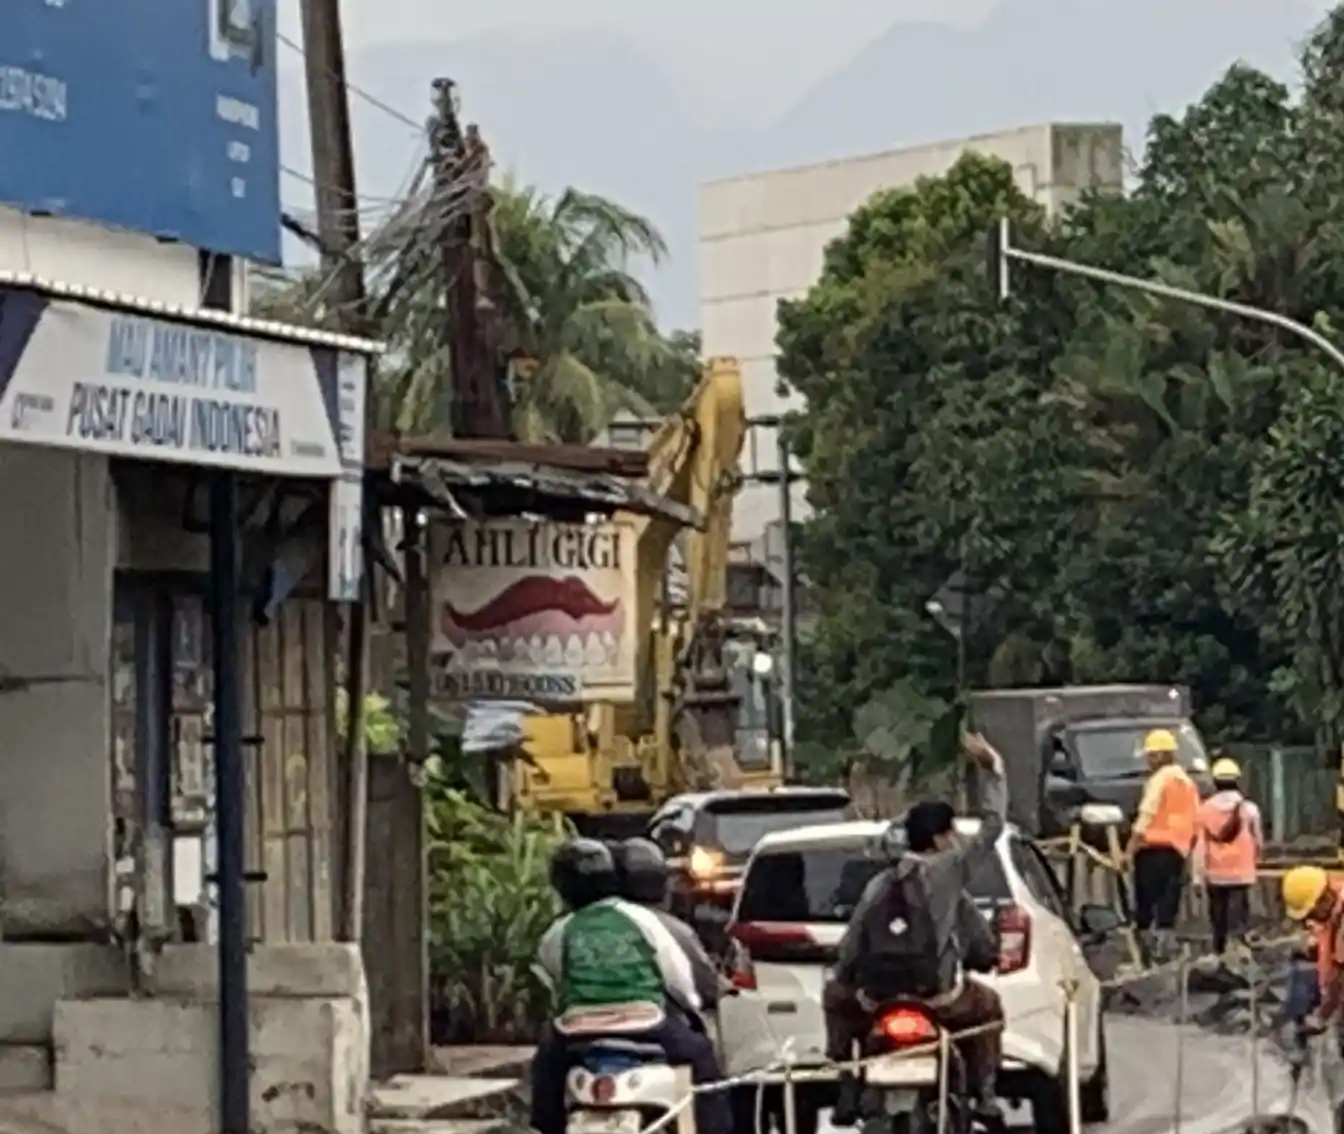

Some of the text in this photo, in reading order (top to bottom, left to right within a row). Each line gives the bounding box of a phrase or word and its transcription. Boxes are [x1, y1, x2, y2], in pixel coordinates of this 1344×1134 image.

[67, 381, 128, 441] PUSAT
[443, 522, 622, 569] AHLI GIGI
